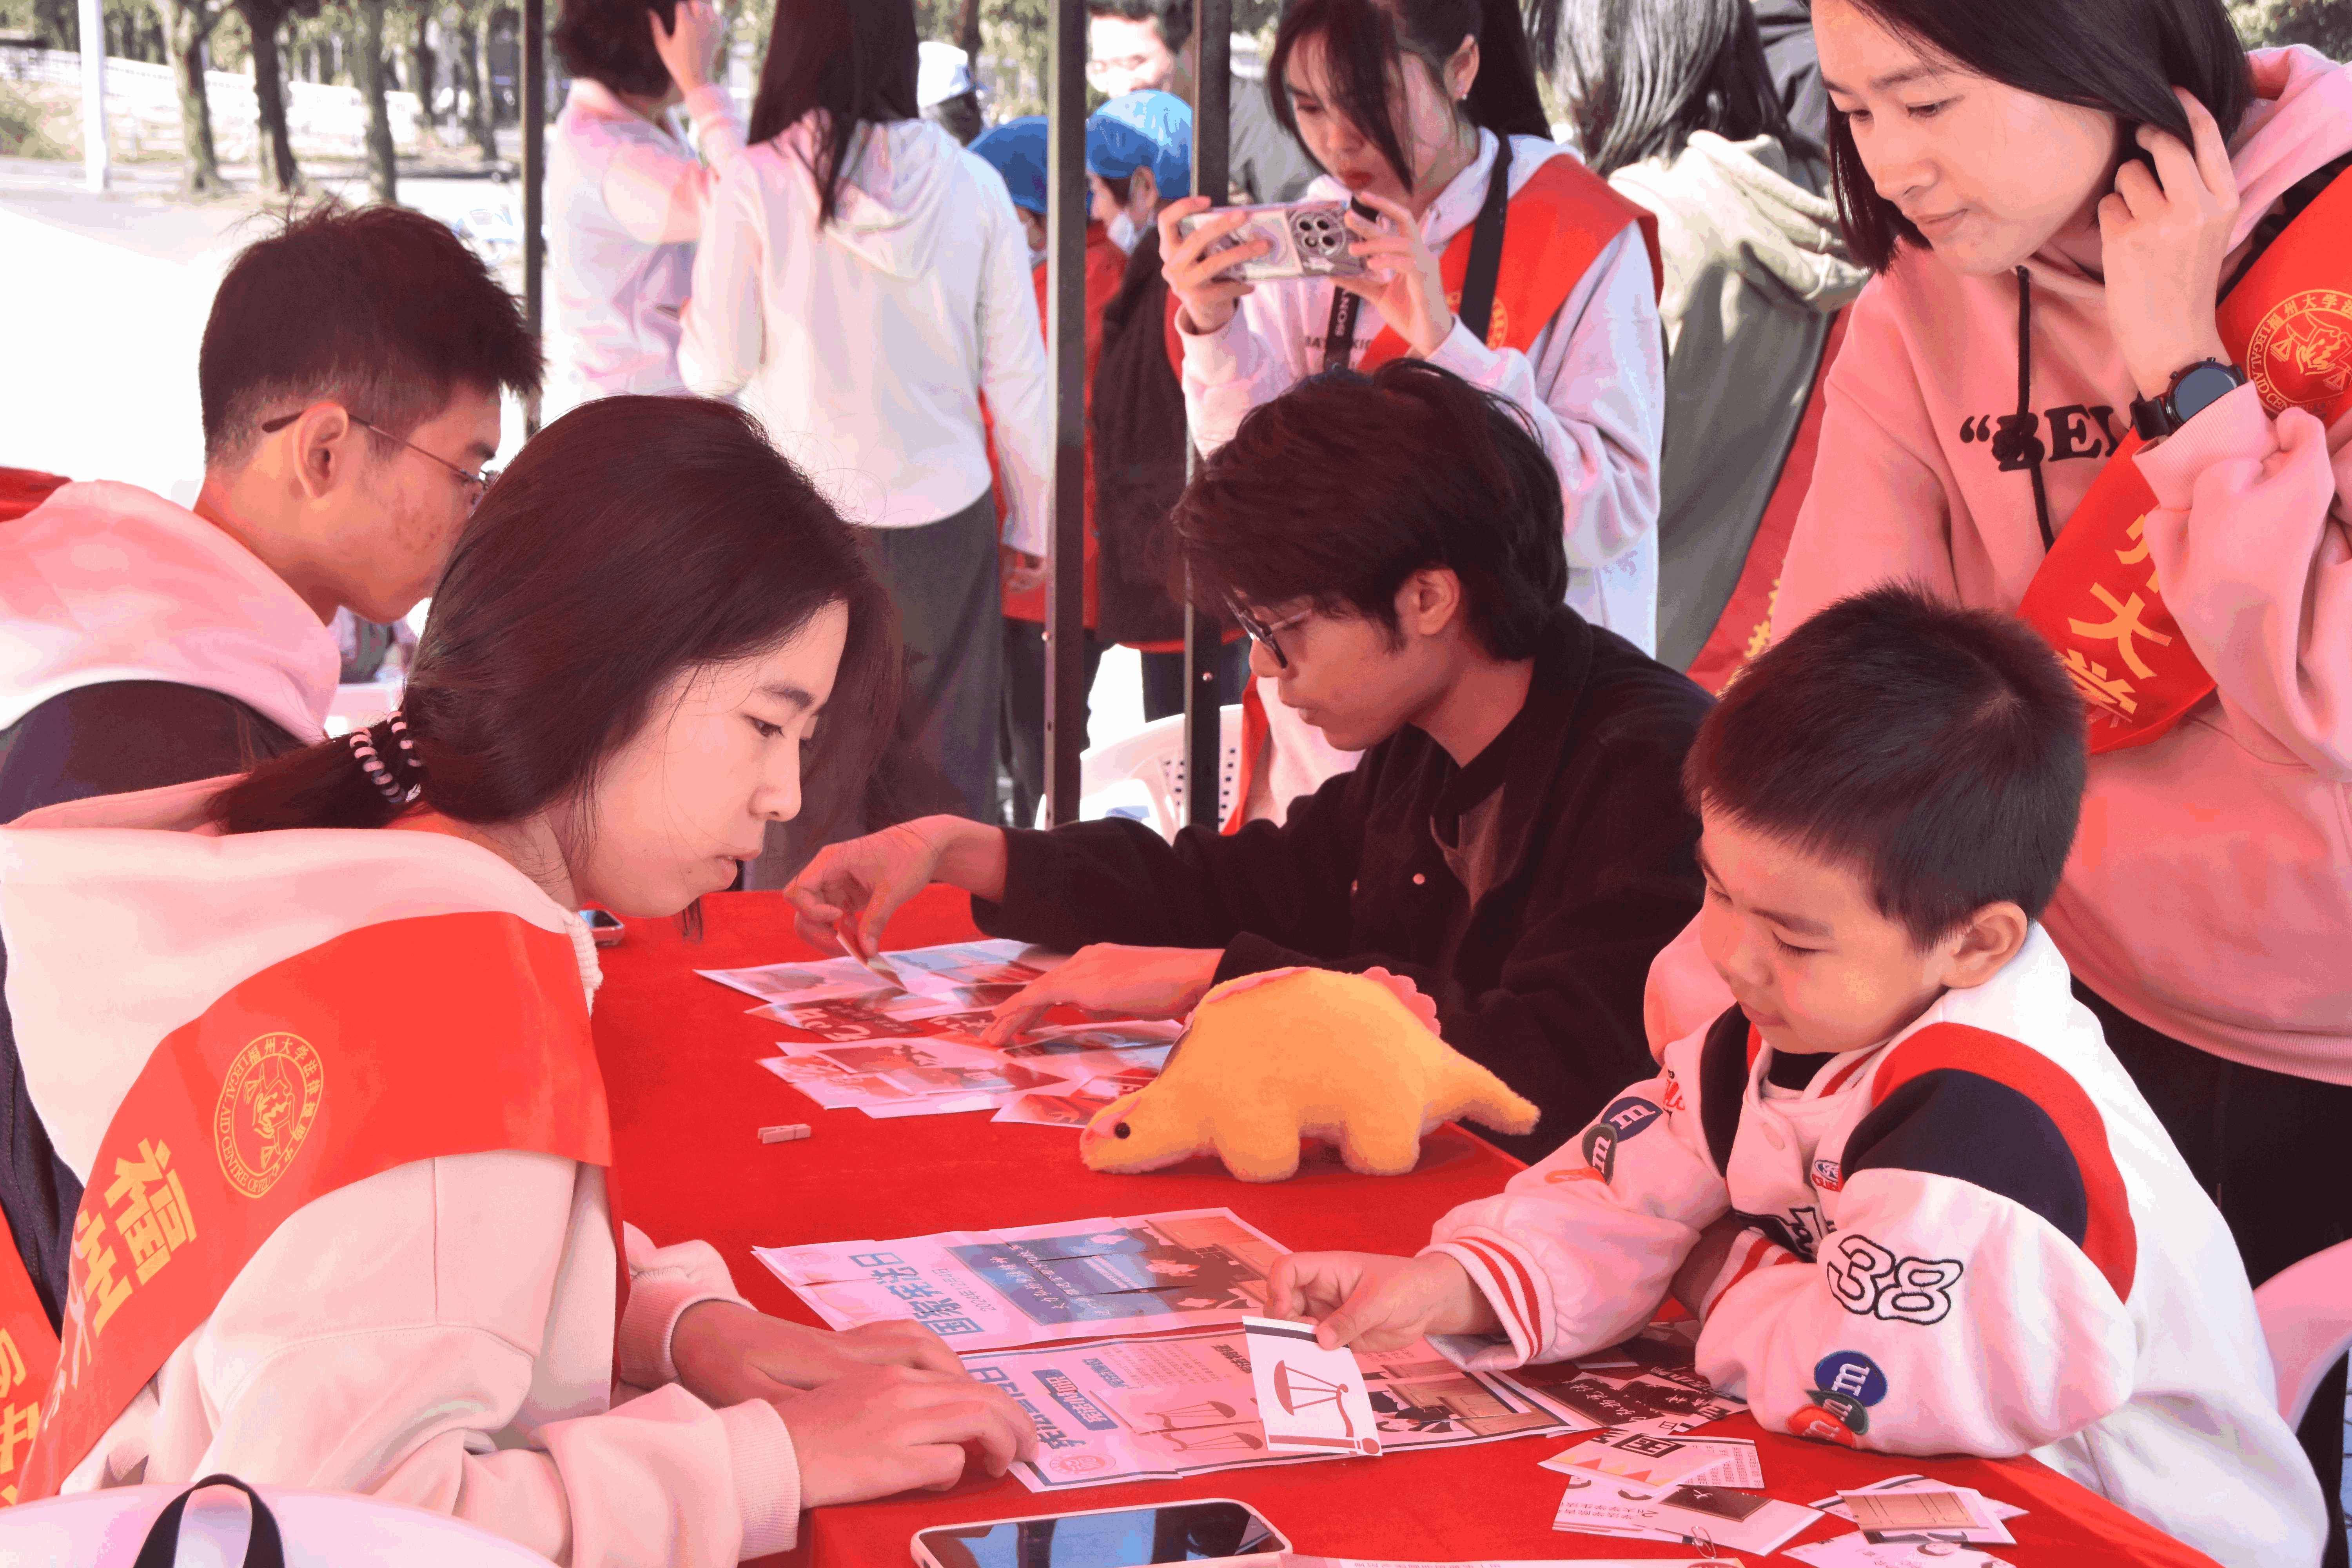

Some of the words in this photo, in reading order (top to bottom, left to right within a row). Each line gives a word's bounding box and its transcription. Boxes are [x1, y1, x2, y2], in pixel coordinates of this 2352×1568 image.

[1334, 289, 1350, 338] SON
[2250, 326, 2272, 369] LEGAL
[2252, 371, 2270, 394] AID
[223, 1054, 250, 1103] LEGAL
[220, 1107, 232, 1134] AID
[221, 1136, 250, 1187] CENTRE
[848, 1251, 985, 1336] 国家宪法日
[932, 1267, 998, 1312] 2024年12月4日
[989, 1256, 1073, 1311] 大力弘扬宪法精神
[1826, 1234, 1965, 1326] 38
[1045, 1372, 1109, 1423] 宪法小知识
